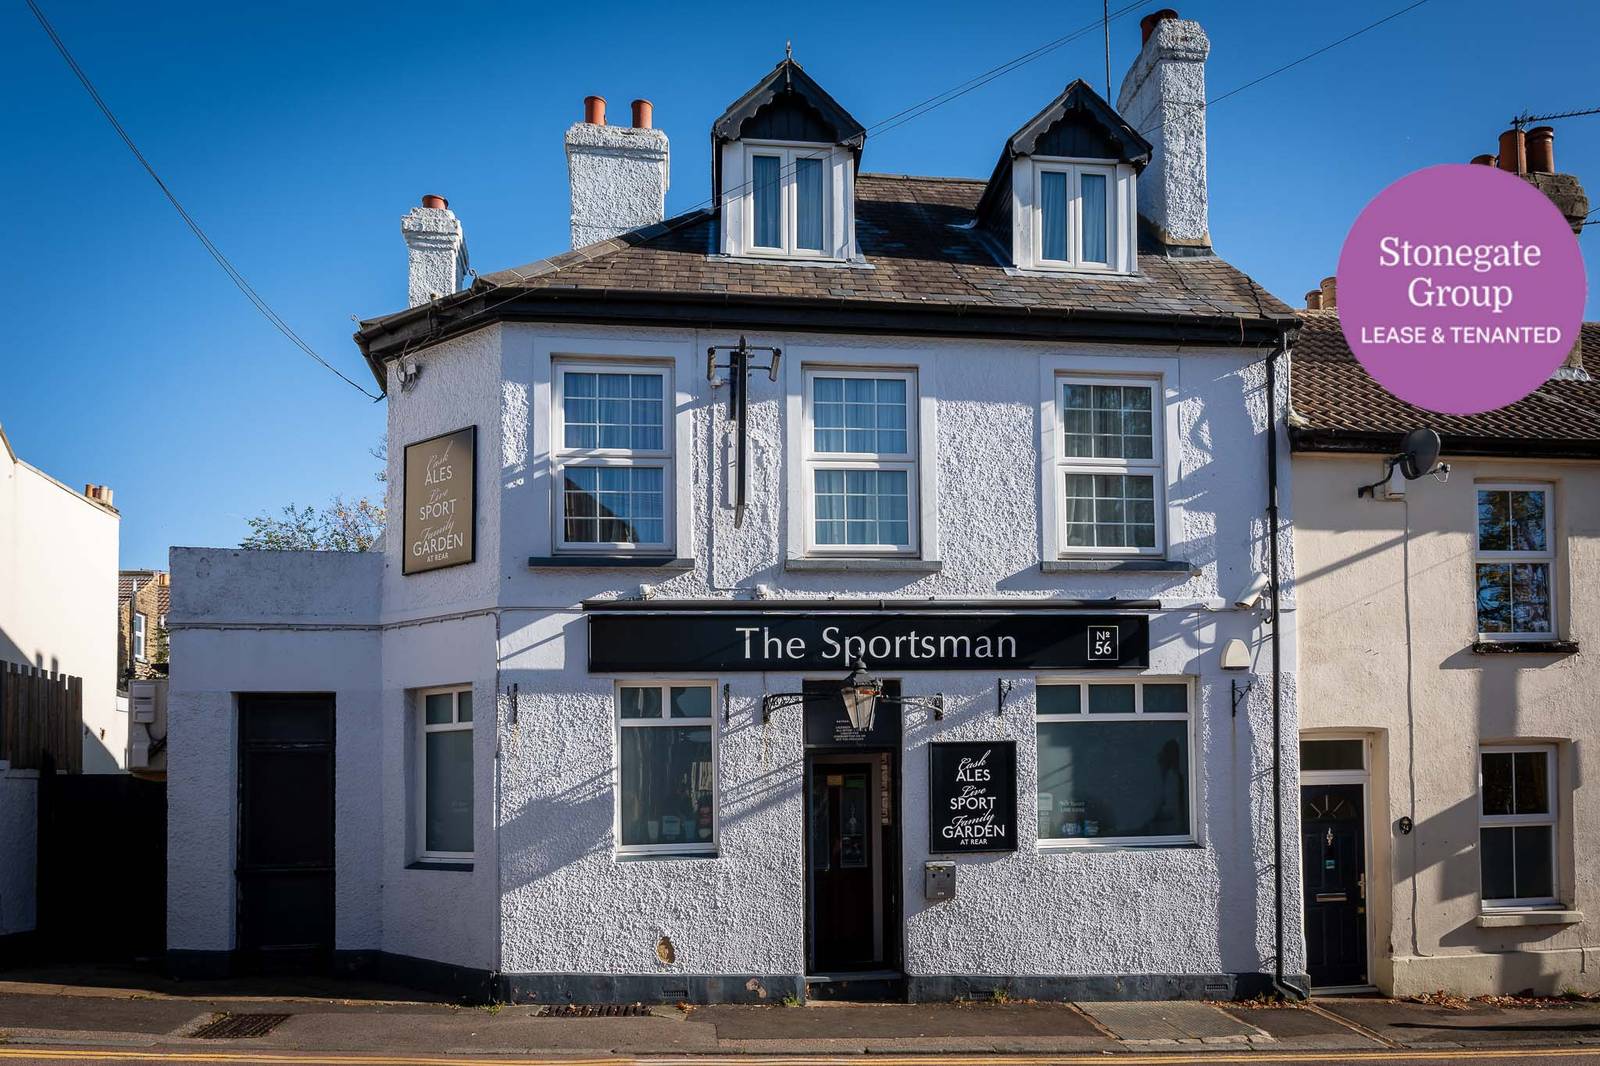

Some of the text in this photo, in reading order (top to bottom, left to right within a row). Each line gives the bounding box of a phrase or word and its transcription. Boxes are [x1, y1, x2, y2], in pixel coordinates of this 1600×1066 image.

[424, 465, 453, 486] ALES
[419, 499, 457, 521] SPORT
[421, 514, 455, 542] Family
[412, 532, 464, 557] GARDEN
[426, 551, 449, 563] AT REAR
[735, 626, 1017, 666] The Sportsman
[1095, 641, 1111, 655] 56
[956, 769, 991, 782] ALES
[960, 785, 987, 799] Live
[950, 797, 997, 810] SPORT
[951, 809, 995, 829] Family
[942, 825, 1005, 839] GARDEN
